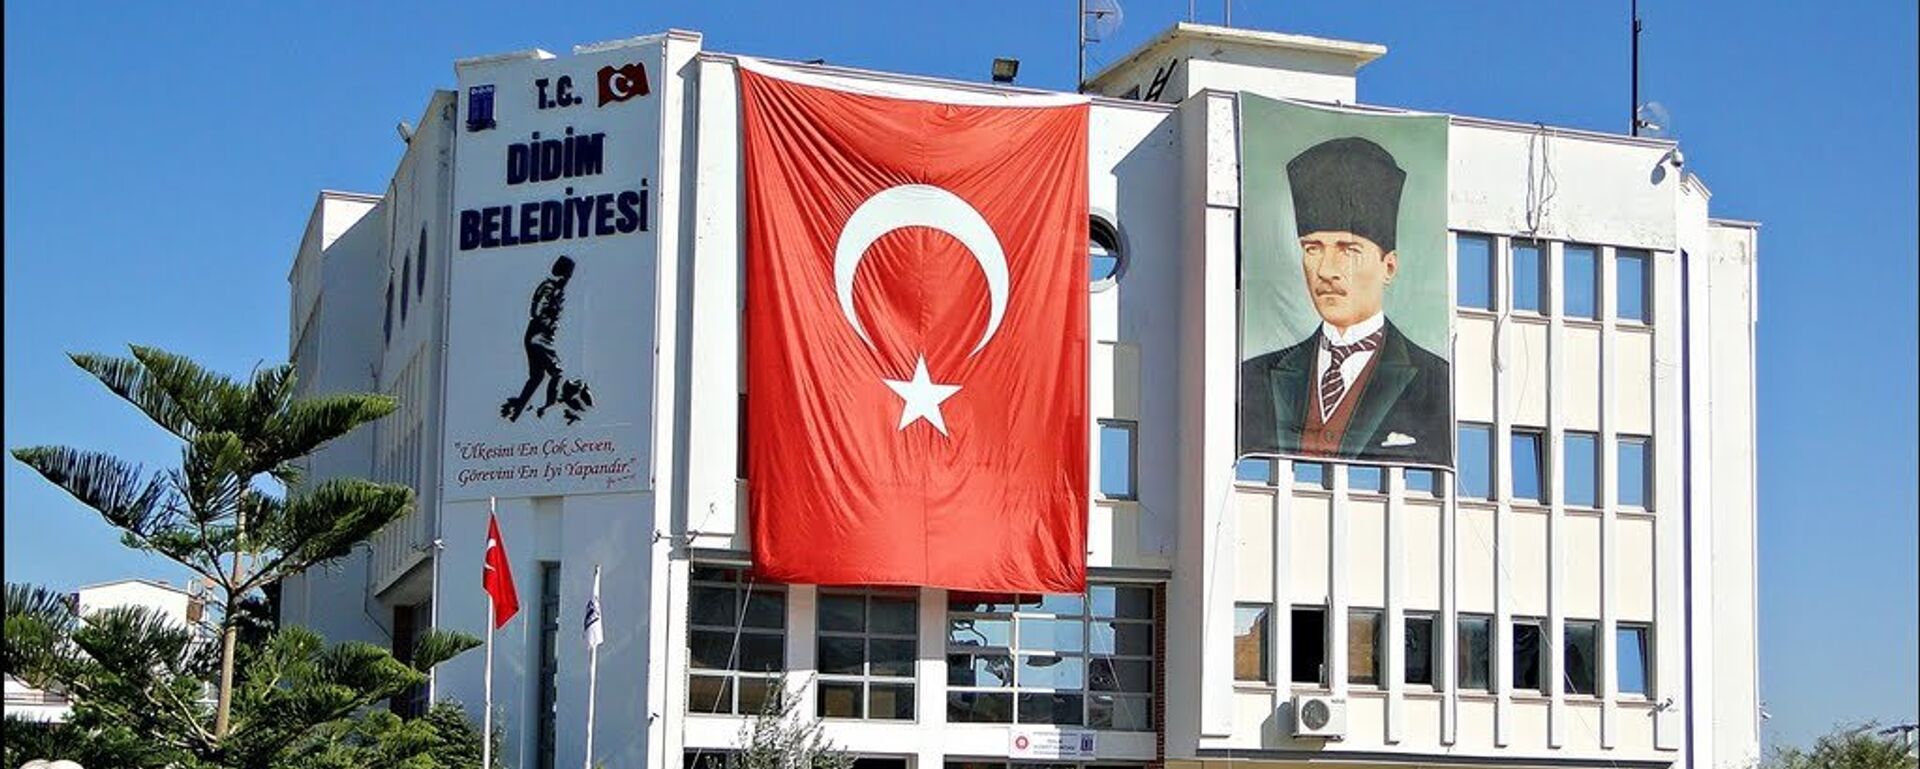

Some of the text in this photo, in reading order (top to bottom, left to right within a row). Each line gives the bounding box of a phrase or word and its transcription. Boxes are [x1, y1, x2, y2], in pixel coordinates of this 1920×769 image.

[535, 75, 583, 109] T.C.
[507, 126, 606, 185] DİDİM
[459, 178, 649, 251] BELEDİYESİ
[519, 442, 539, 457] En
[542, 438, 571, 458] Çok
[571, 437, 616, 454] Seven,
[457, 466, 515, 487] Görevini
[518, 464, 539, 479] En
[543, 461, 563, 482] İyi
